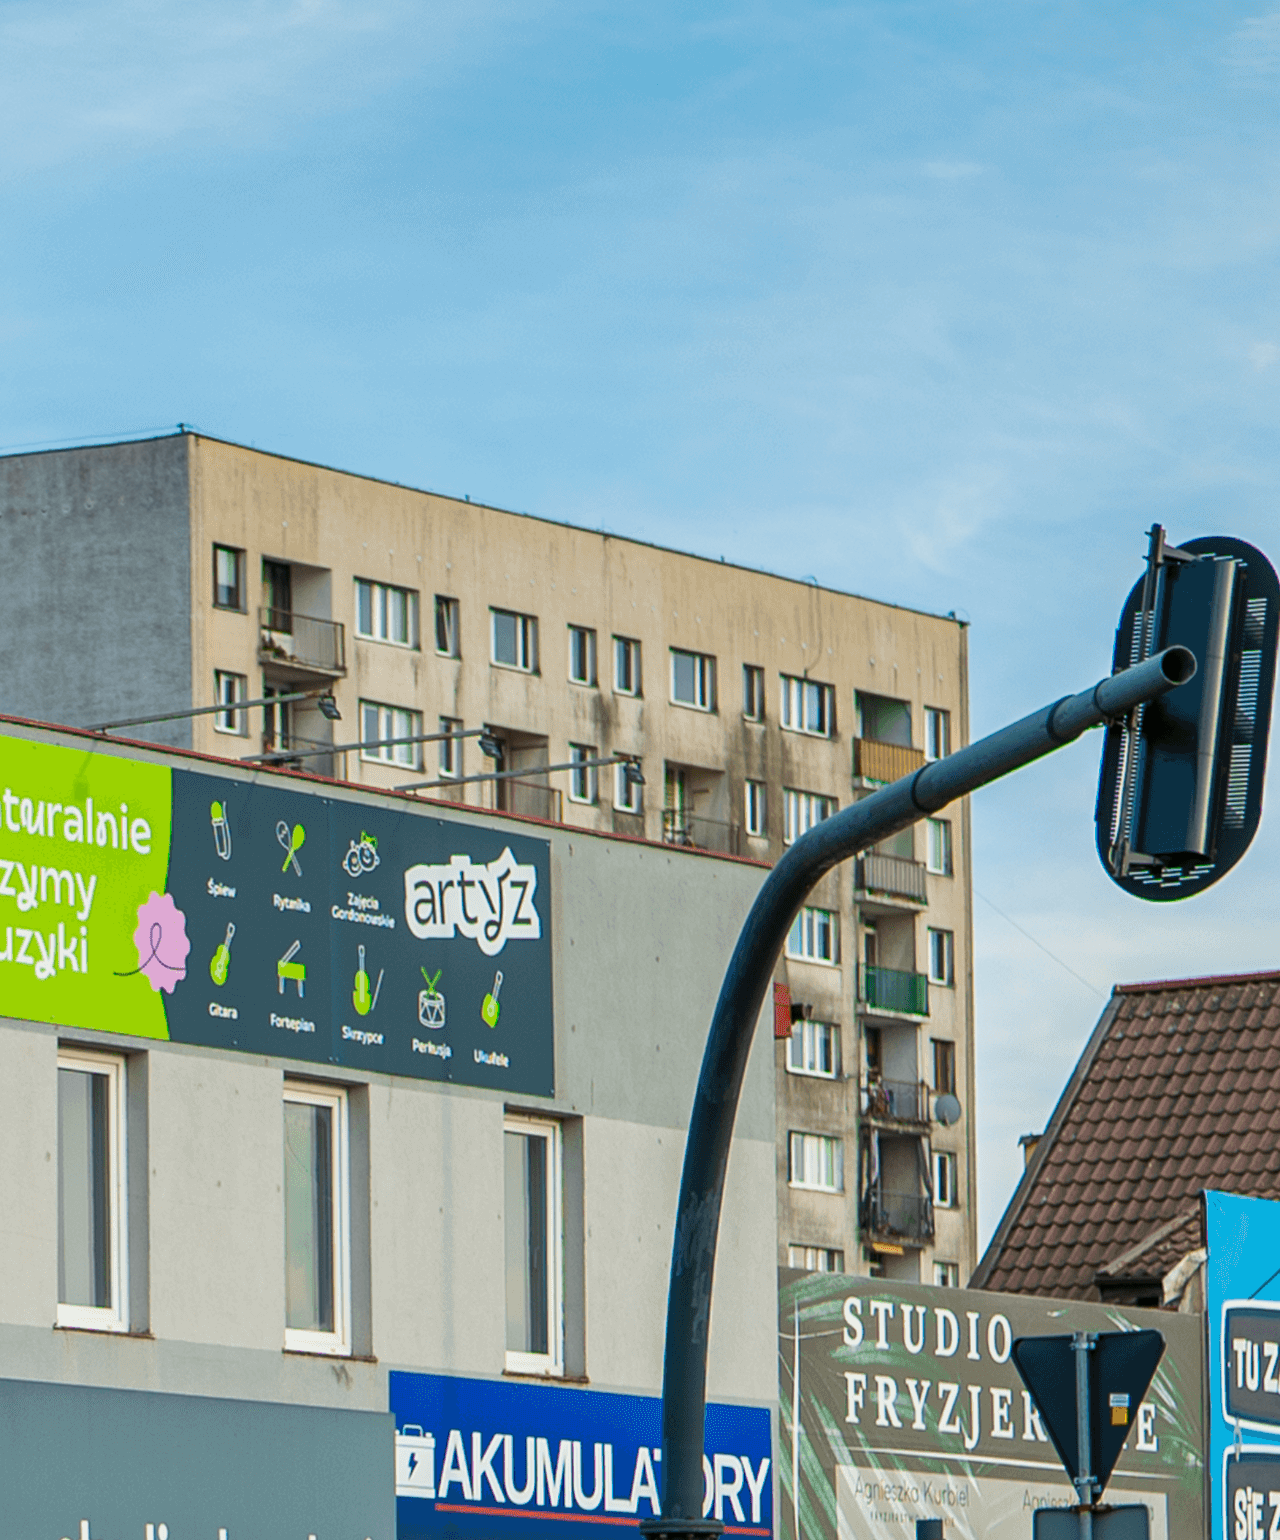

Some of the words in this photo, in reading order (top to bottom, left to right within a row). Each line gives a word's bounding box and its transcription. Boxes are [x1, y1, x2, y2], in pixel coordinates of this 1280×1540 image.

[413, 868, 532, 942] artyz
[208, 1002, 238, 1019] Gitara
[270, 1013, 315, 1032] Fortepian
[342, 1025, 384, 1045] Skrzypce
[842, 1296, 1013, 1364] STUDIO
[1232, 1337, 1258, 1391] TU
[844, 1371, 1158, 1453] FRYZJERE
[438, 1429, 770, 1524] AKUMULARY
